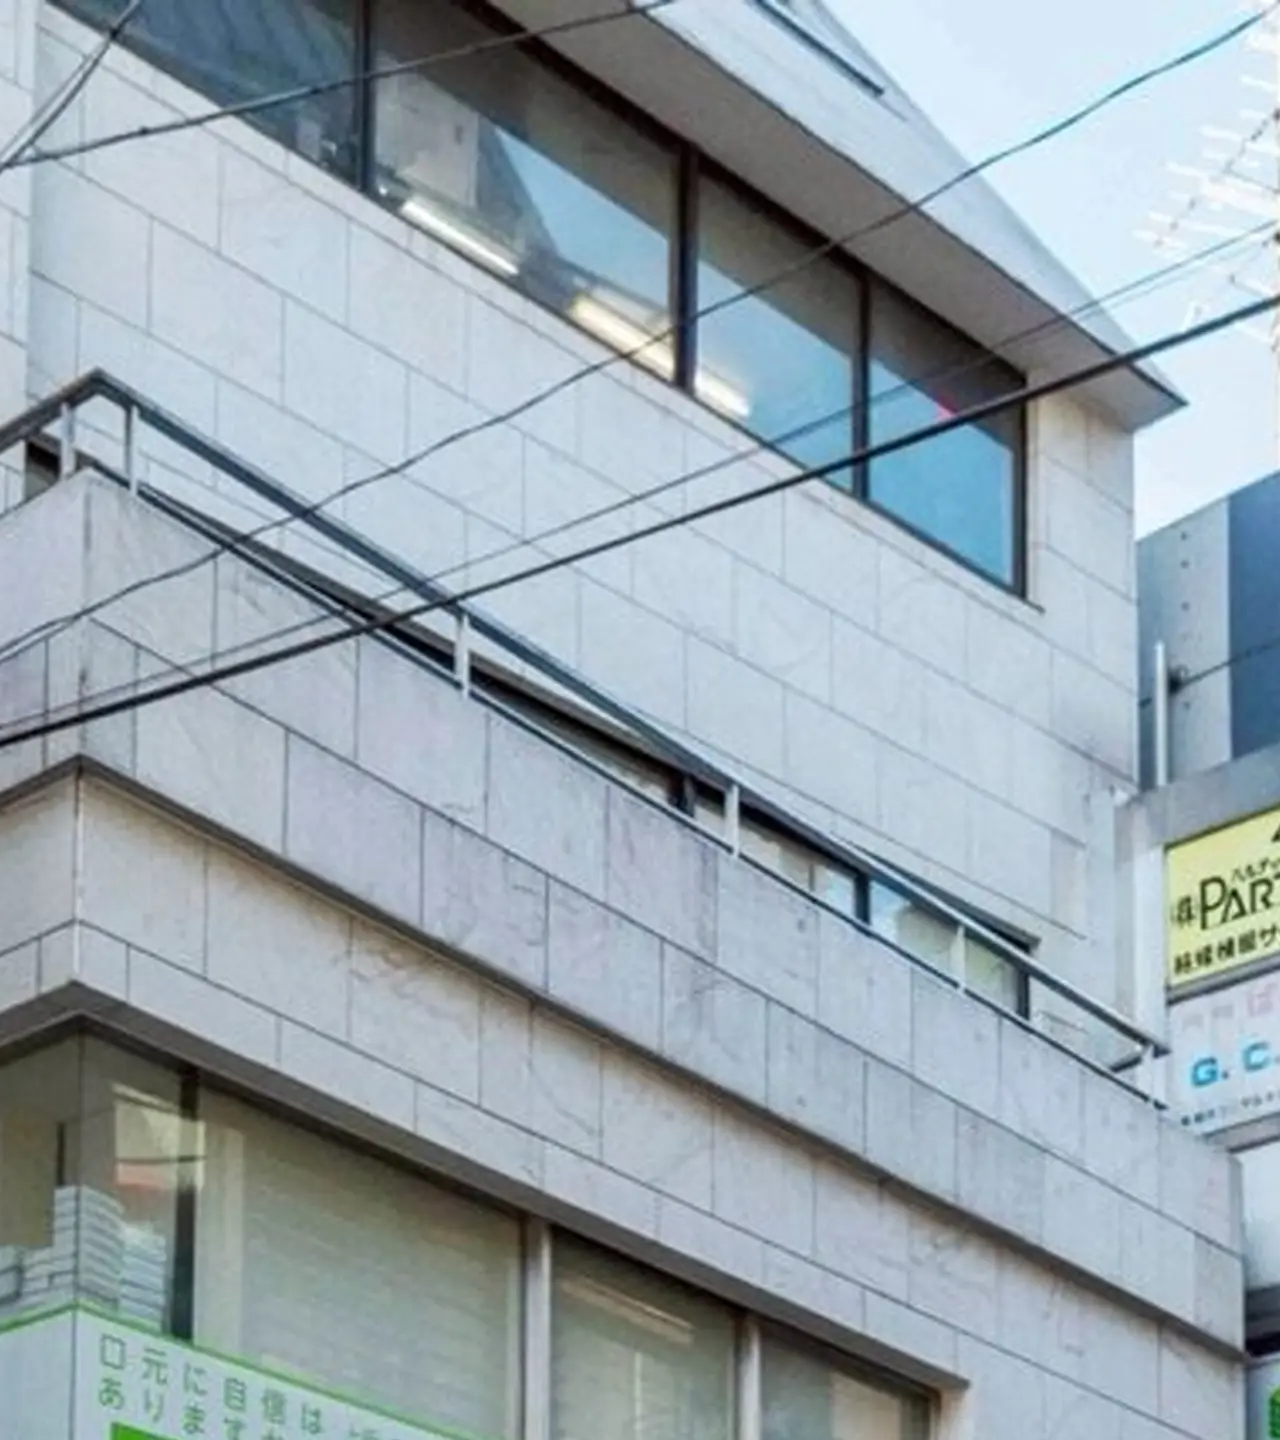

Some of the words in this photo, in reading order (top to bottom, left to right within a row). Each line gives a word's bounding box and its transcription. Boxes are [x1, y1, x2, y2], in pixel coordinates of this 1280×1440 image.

[99, 1334, 323, 1434] 口元に自信は
